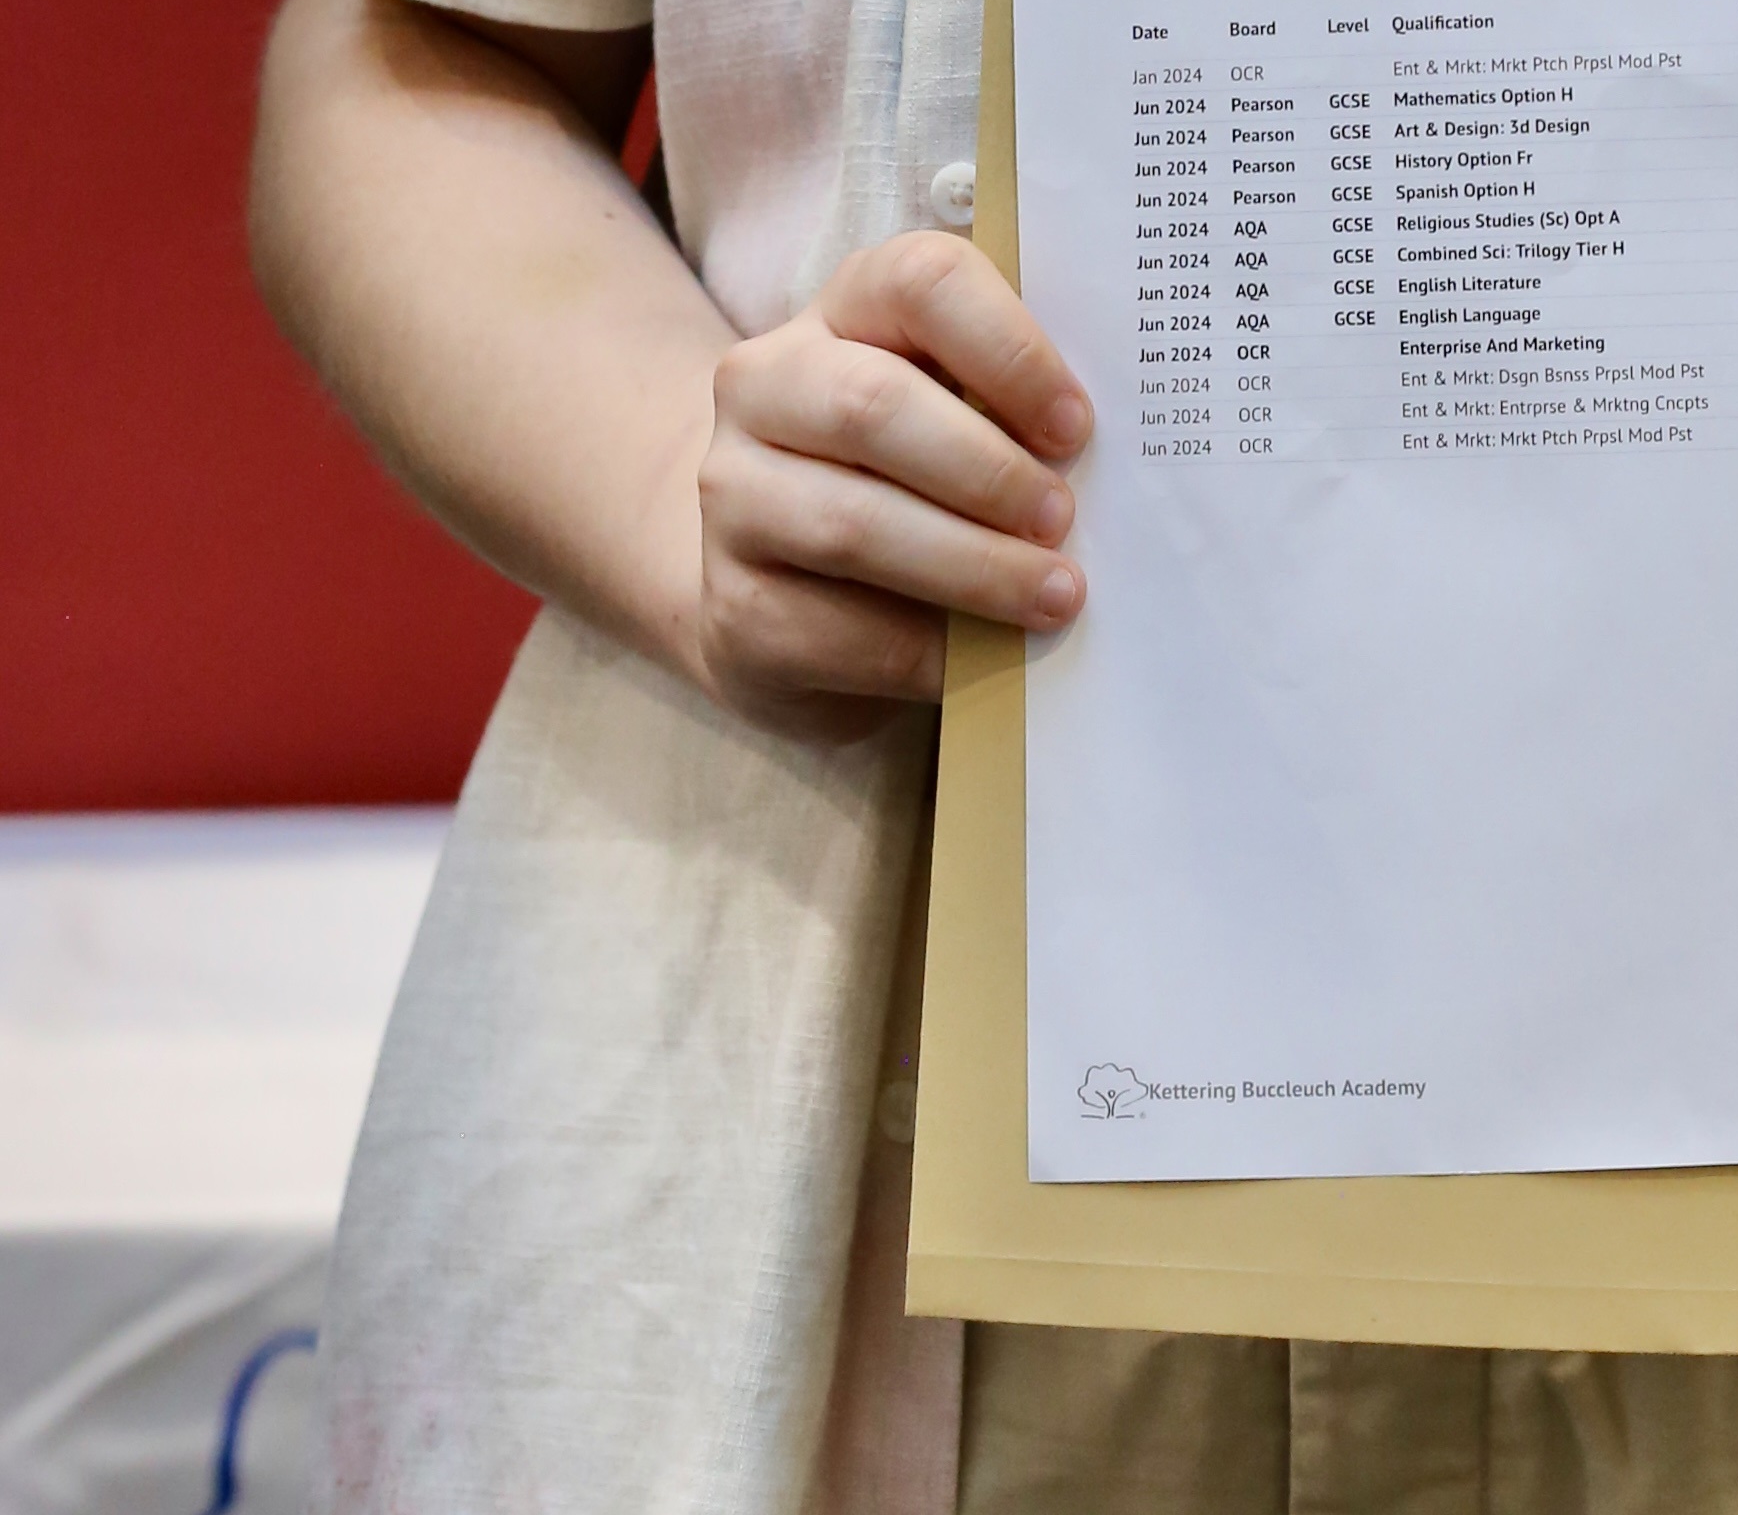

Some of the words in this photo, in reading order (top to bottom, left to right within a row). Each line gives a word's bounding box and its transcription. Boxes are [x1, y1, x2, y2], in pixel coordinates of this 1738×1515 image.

[1132, 25, 1168, 40] Date
[1230, 21, 1276, 37] Board
[1328, 17, 1369, 34] Level
[1392, 14, 1494, 35] Qualification
[1133, 101, 1159, 115] Jun
[1165, 98, 1206, 115] 2024
[1231, 98, 1294, 112] Pearson
[1329, 93, 1370, 109] GCSE
[1394, 89, 1496, 107] Mathematics
[1502, 88, 1556, 107] Option
[1561, 87, 1573, 102] H
[1134, 131, 1160, 146] Jun
[1166, 129, 1207, 145] 2024
[1232, 128, 1294, 143] Pearson
[1330, 124, 1371, 140] GCSE
[1394, 123, 1419, 138] Art
[1426, 122, 1438, 137] &
[1445, 120, 1504, 139] Design:
[1510, 119, 1529, 134] 3d
[1535, 118, 1590, 136] Design
[1135, 162, 1161, 177] Jun
[1167, 160, 1208, 176] 2024
[1233, 159, 1295, 174] Pearson
[1331, 155, 1372, 171] GCSE
[1396, 154, 1453, 171] History
[1458, 151, 1512, 170] Option
[1517, 150, 1533, 165] Fr
[1135, 193, 1162, 208] Jun
[1168, 191, 1208, 207] 2024
[1234, 190, 1296, 205] Pearson
[1331, 186, 1373, 202] GCSE
[1396, 183, 1458, 203] Spanish
[1464, 182, 1518, 201] Option
[1524, 180, 1535, 196] H
[1136, 224, 1162, 239] Jun
[1168, 222, 1209, 238] 2024
[1234, 220, 1267, 239] AQA
[1332, 217, 1373, 233] GCSE
[1397, 215, 1470, 234] Religious
[1475, 212, 1534, 228] Studies
[1540, 211, 1569, 230] (Sc)
[1575, 210, 1604, 229] Opt
[1609, 209, 1620, 224] A
[1137, 255, 1163, 270] Jun
[1169, 253, 1210, 269] 2024
[1234, 252, 1268, 271] AQA
[1333, 248, 1374, 264] GCSE
[1398, 245, 1477, 262] Combined
[1483, 244, 1511, 259] Sci:
[1515, 243, 1571, 261] Trilogy
[1575, 241, 1608, 257] Tier
[1613, 240, 1624, 255] H
[1137, 286, 1164, 301] Jun
[1170, 284, 1211, 300] 2024
[1235, 282, 1269, 301] AQA
[1334, 279, 1375, 295] GCSE
[1399, 277, 1456, 296] English
[1462, 276, 1541, 291] Literature
[1138, 317, 1164, 332] Jun
[1170, 315, 1212, 331] 2024
[1236, 314, 1270, 333] AQA
[1334, 310, 1376, 326] GCSE
[1399, 308, 1457, 328] English
[1463, 307, 1540, 326] Language
[1139, 348, 1165, 363] Jun
[1171, 346, 1212, 362] 2024
[1237, 345, 1270, 360] OCR
[1400, 339, 1481, 358] Enterprise
[1486, 337, 1518, 353] And
[1524, 335, 1604, 354] Marketing
[1238, 376, 1271, 391] OCR
[1401, 372, 1427, 387] Ent
[1434, 371, 1446, 386] &
[1454, 370, 1494, 385] Mrkt:
[1499, 369, 1539, 387] Dsgn
[1545, 367, 1589, 383] Bsnss
[1596, 365, 1635, 385] Prpsl
[1641, 364, 1674, 379] Mod
[1681, 363, 1704, 378] Pst
[1150, 1082, 1235, 1103] Kettering
[1243, 1080, 1335, 1098] Buccleuch
[1342, 1079, 1426, 1099] Academy
